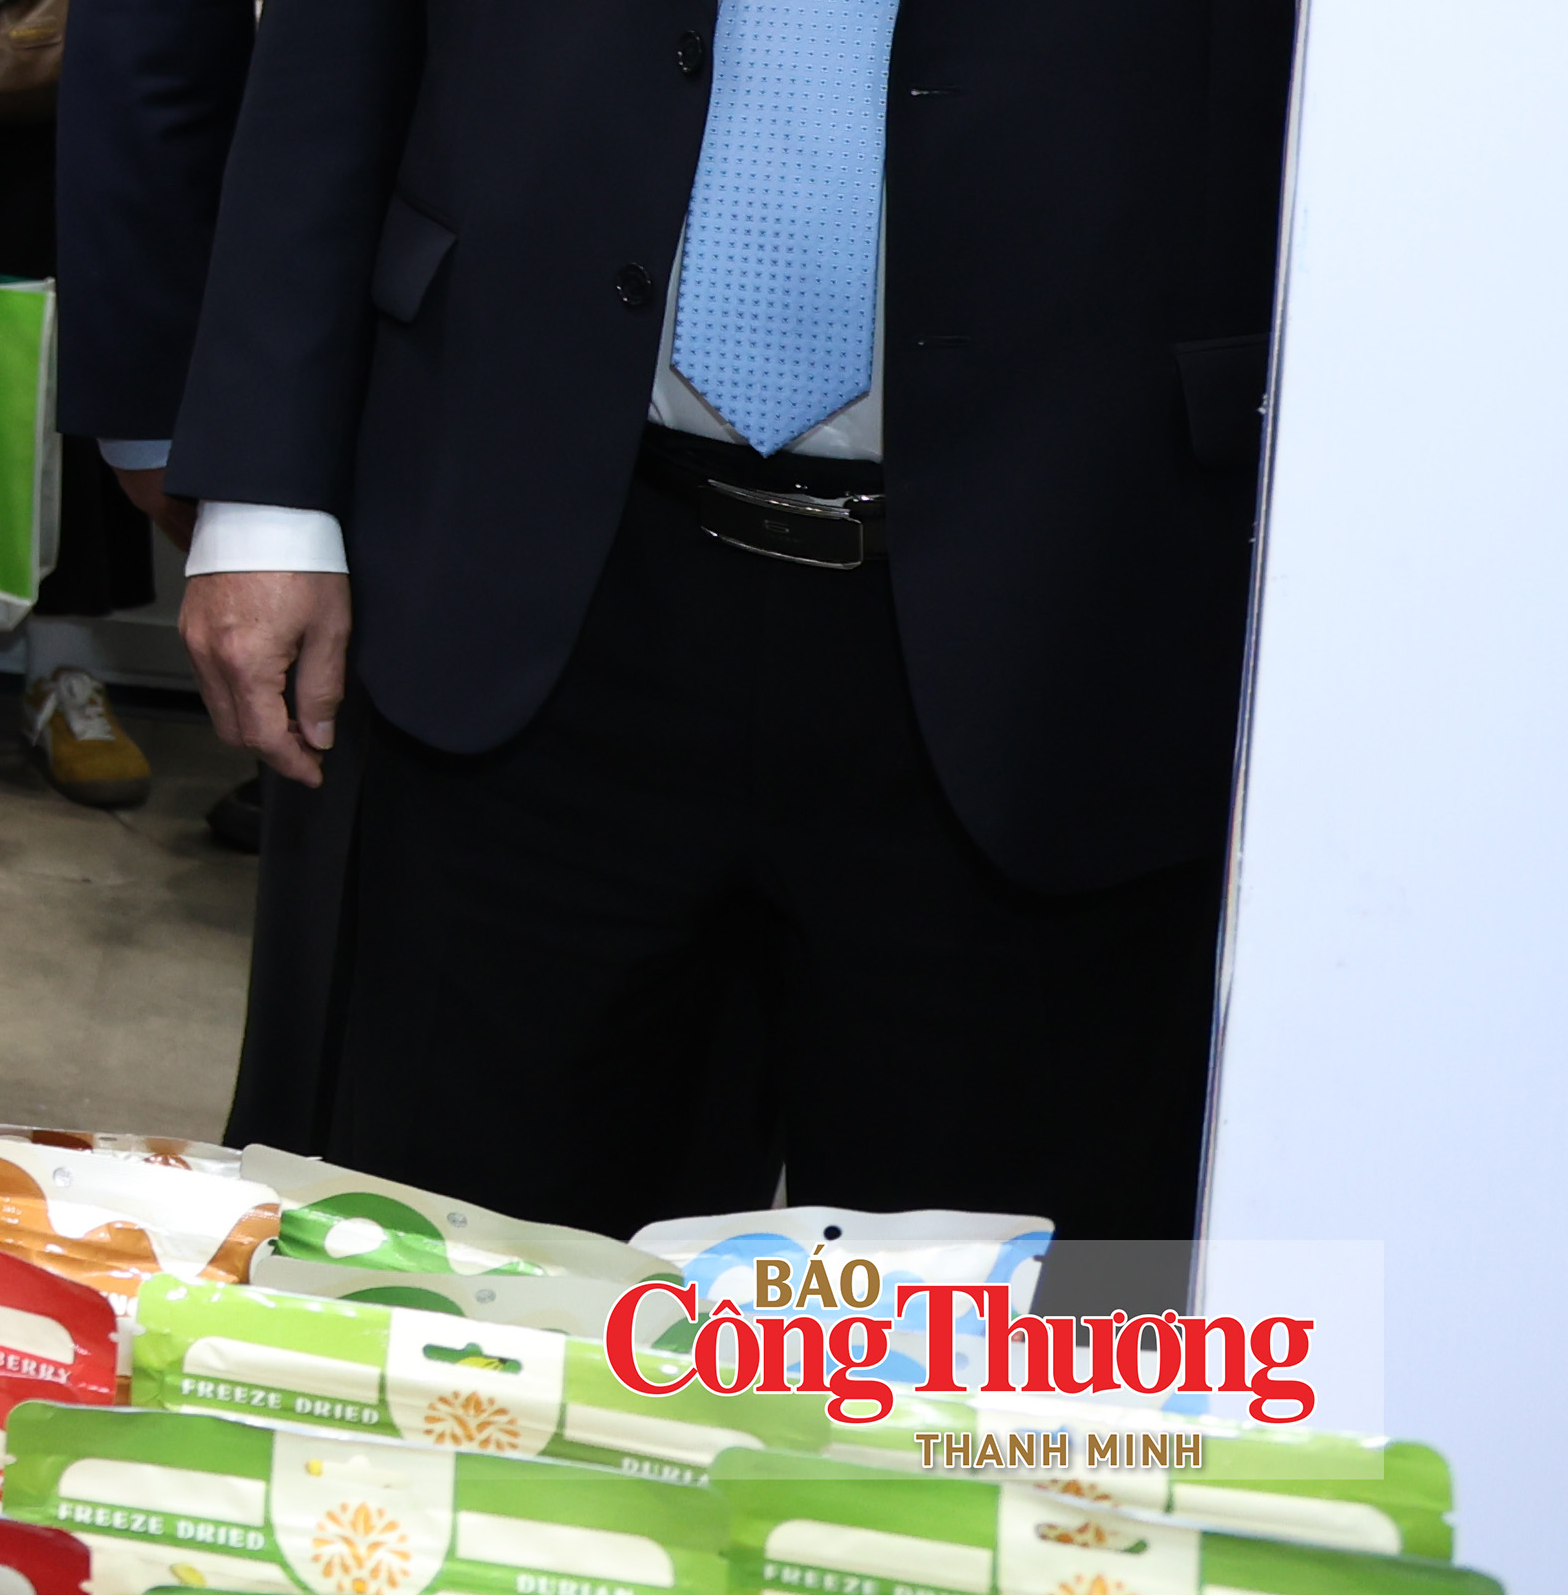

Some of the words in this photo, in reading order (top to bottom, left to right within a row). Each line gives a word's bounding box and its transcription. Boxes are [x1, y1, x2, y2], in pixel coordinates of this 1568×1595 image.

[180, 1378, 282, 1410] FREEZE
[294, 1396, 380, 1426] DRIED
[620, 1457, 710, 1487] DURIA
[57, 1503, 164, 1536] FREEZE
[175, 1517, 265, 1552] DRIED
